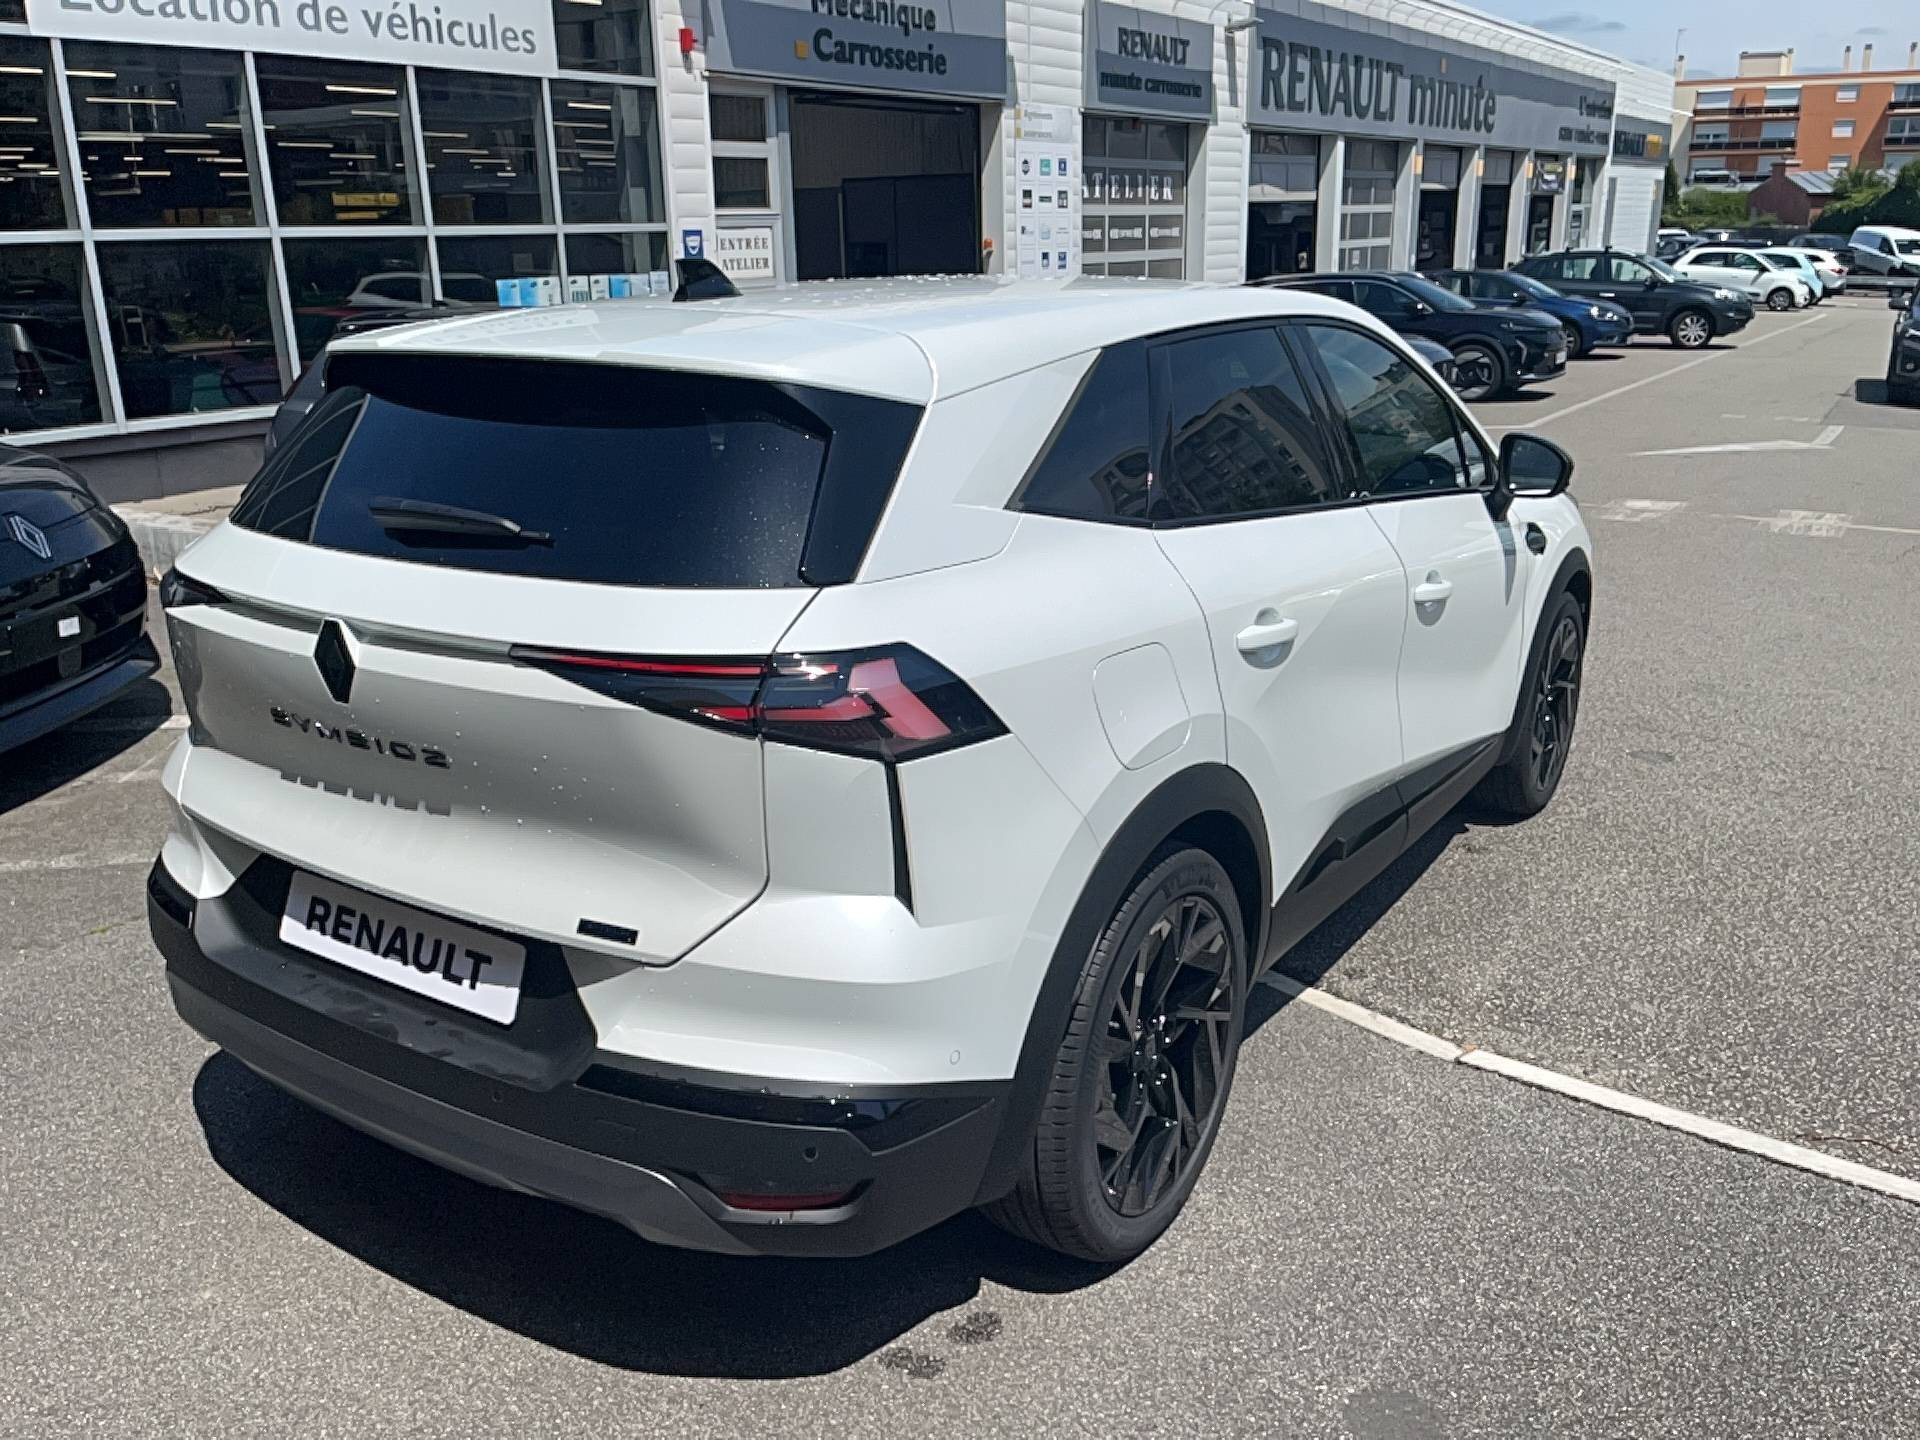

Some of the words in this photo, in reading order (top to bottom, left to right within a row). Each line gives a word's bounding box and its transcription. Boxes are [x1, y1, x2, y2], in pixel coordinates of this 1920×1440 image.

[297, 0, 348, 34] de
[361, 1, 536, 54] véhicules
[812, 28, 947, 75] Carrosserie
[1118, 27, 1190, 65] RENAULT
[1261, 36, 1403, 122] RENAULT
[722, 257, 769, 271] ATELIER
[306, 895, 493, 990] RENAULT
